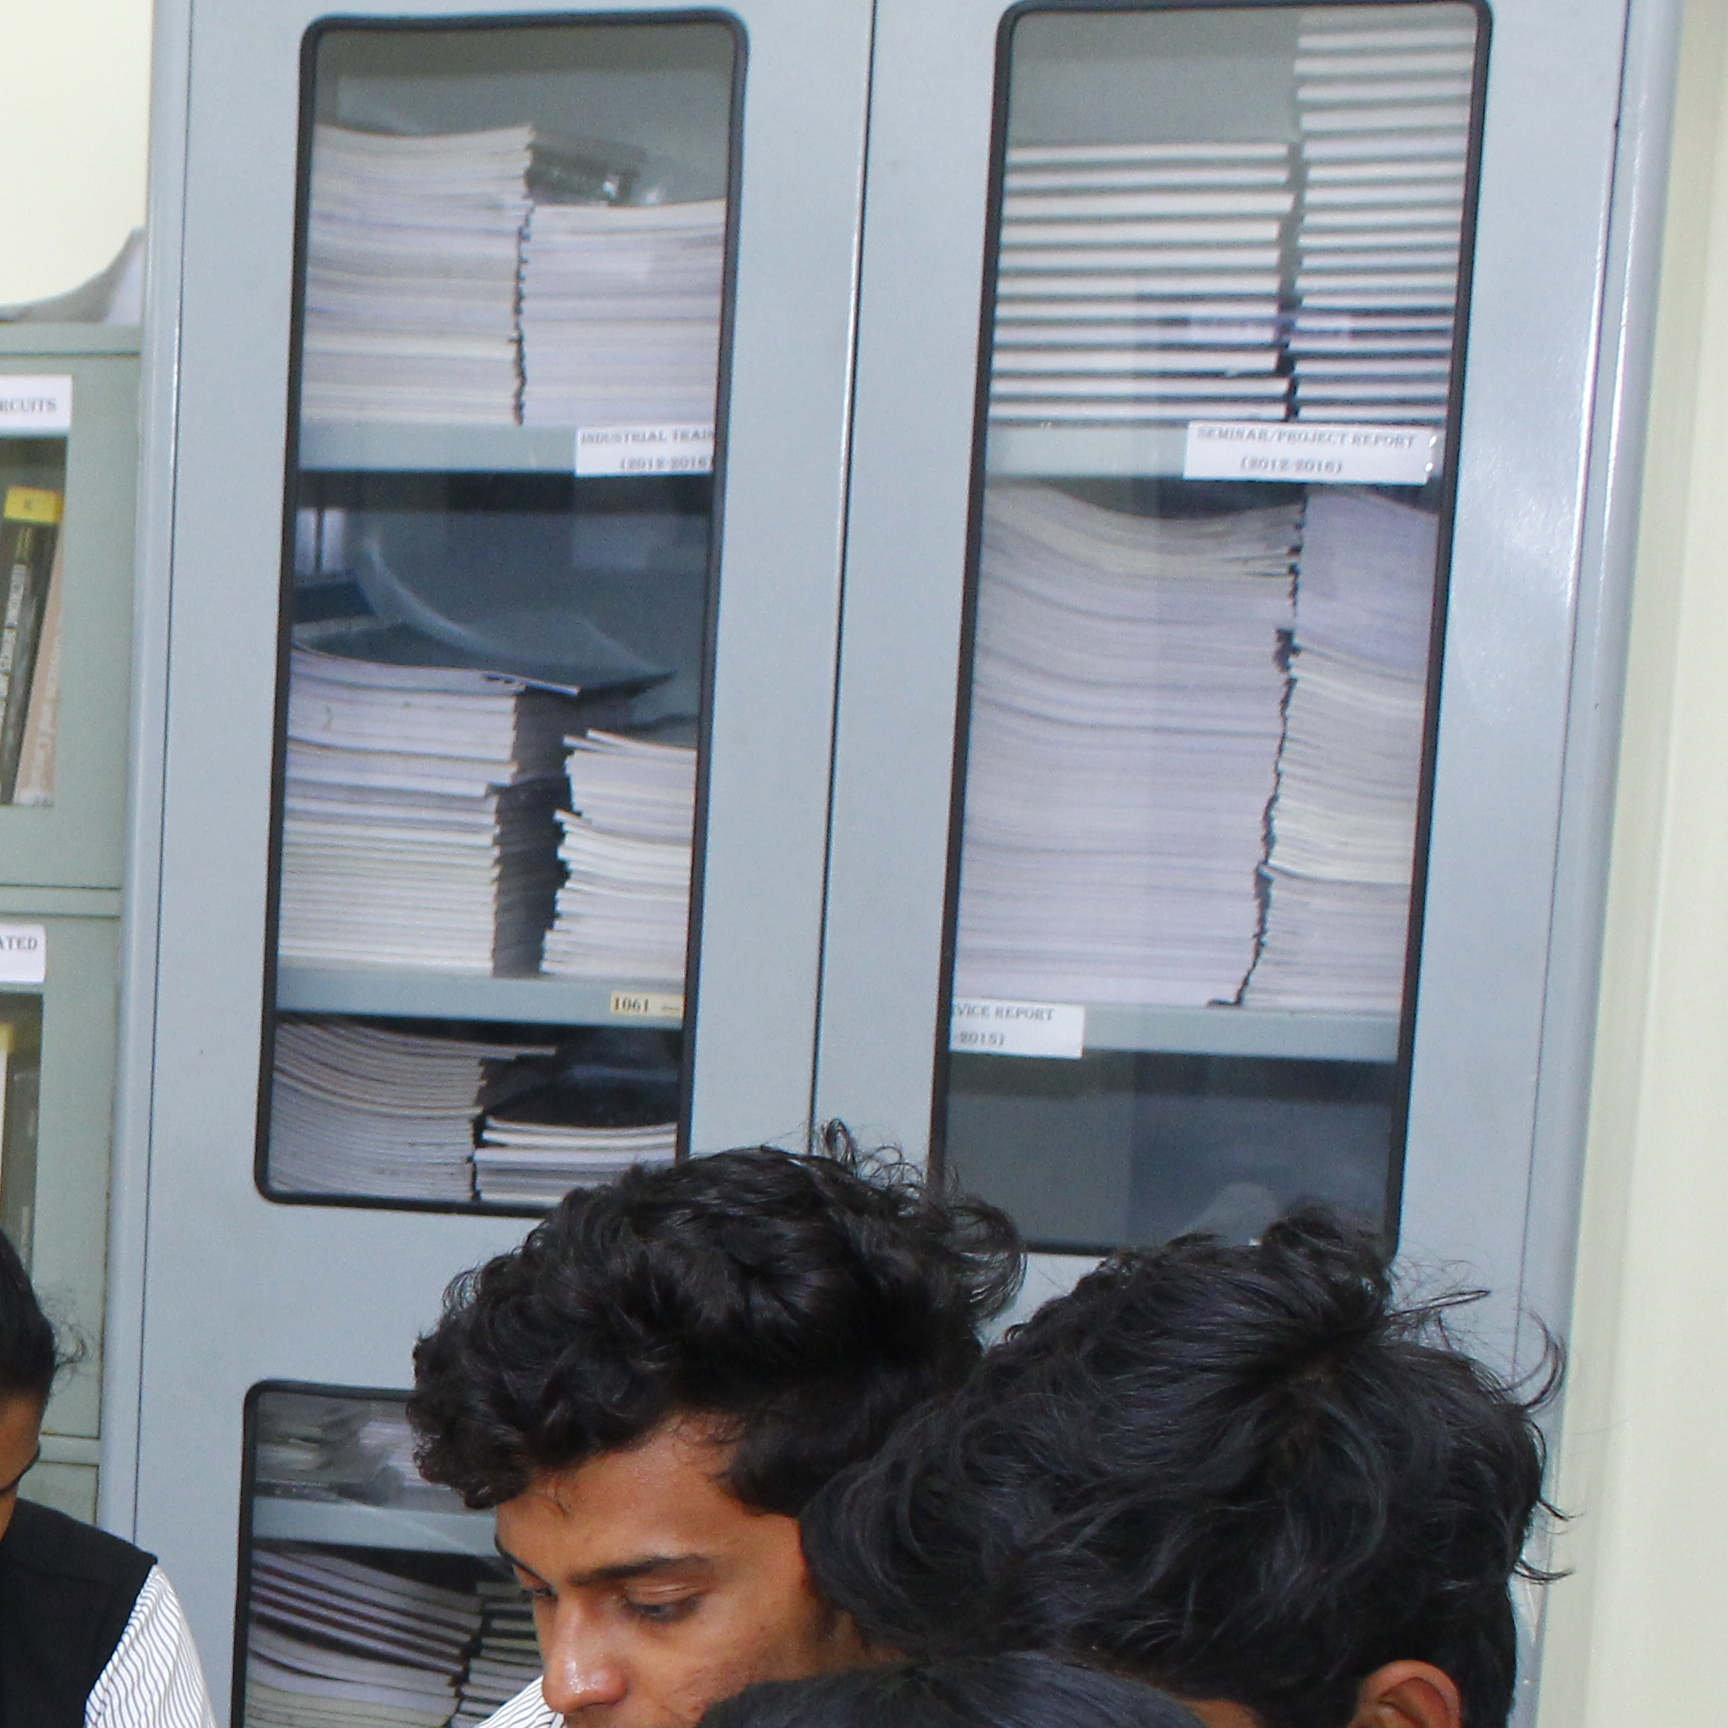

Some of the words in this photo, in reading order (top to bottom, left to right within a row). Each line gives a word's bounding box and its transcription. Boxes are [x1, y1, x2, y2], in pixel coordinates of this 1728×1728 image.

[581, 429, 668, 445] INDUSTRIAL
[1196, 426, 1347, 447] SEMINAR/PROJECT
[1351, 430, 1417, 448] REPORT
[614, 997, 649, 1012] 1061
[995, 1004, 1053, 1021] REPORT
